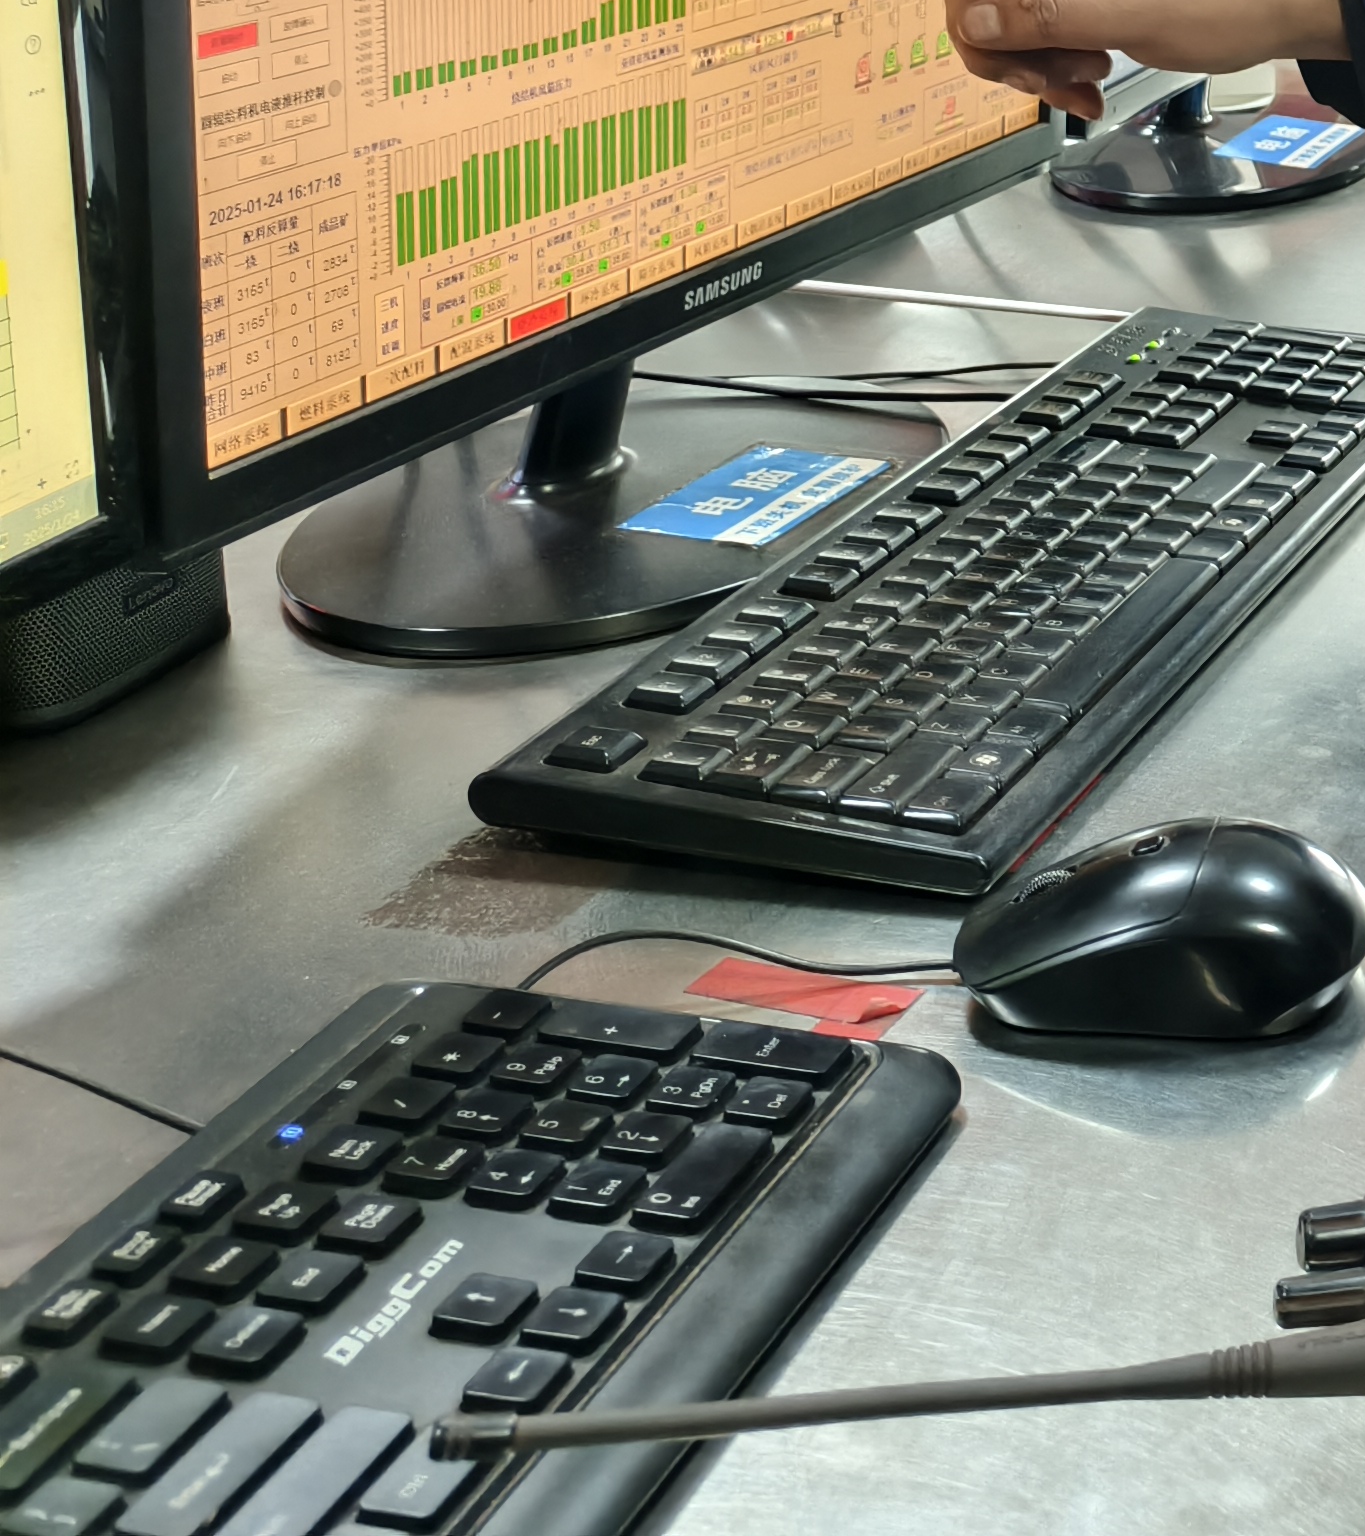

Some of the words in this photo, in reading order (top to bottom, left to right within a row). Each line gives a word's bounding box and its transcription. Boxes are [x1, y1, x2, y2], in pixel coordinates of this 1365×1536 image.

[208, 189, 284, 227] 2025-01-24
[288, 172, 342, 201] 16:17:18
[290, 271, 297, 283] 0
[684, 261, 763, 311] SAMSUNG
[290, 303, 297, 315] 0
[292, 336, 299, 348] 0
[293, 368, 300, 380] 0
[691, 467, 800, 516] 电脑
[960, 693, 981, 702] X
[756, 1037, 781, 1058] Enter
[506, 1062, 526, 1071] 9
[534, 1055, 563, 1075] PgUp
[585, 1075, 605, 1084] 6
[663, 1085, 683, 1095] 3
[690, 1077, 719, 1098] PgDn
[767, 1094, 788, 1109] Del
[457, 1109, 477, 1118] 8
[538, 1119, 559, 1129] 5
[617, 1130, 640, 1140] 2
[403, 1156, 425, 1165] 7
[434, 1148, 467, 1170] Home
[489, 1171, 509, 1180] 4
[598, 1179, 622, 1196] End
[650, 1193, 672, 1203] 0
